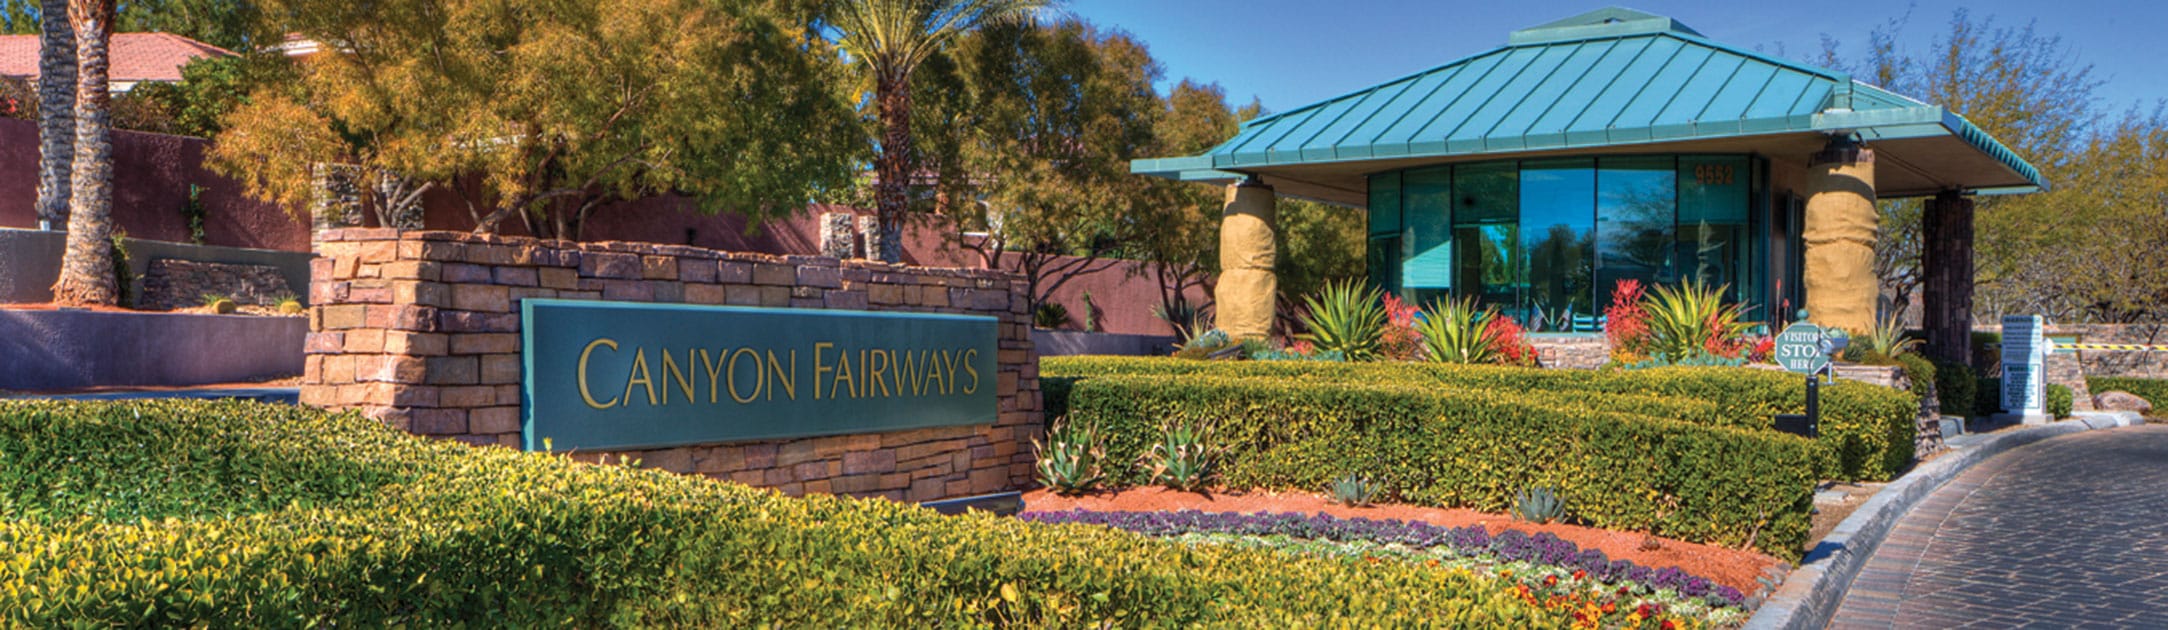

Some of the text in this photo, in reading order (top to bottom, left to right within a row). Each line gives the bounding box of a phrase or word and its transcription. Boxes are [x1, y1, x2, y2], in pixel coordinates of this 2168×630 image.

[1695, 164, 1734, 185] 9552
[576, 338, 979, 409] CANYON FAIRWAYS
